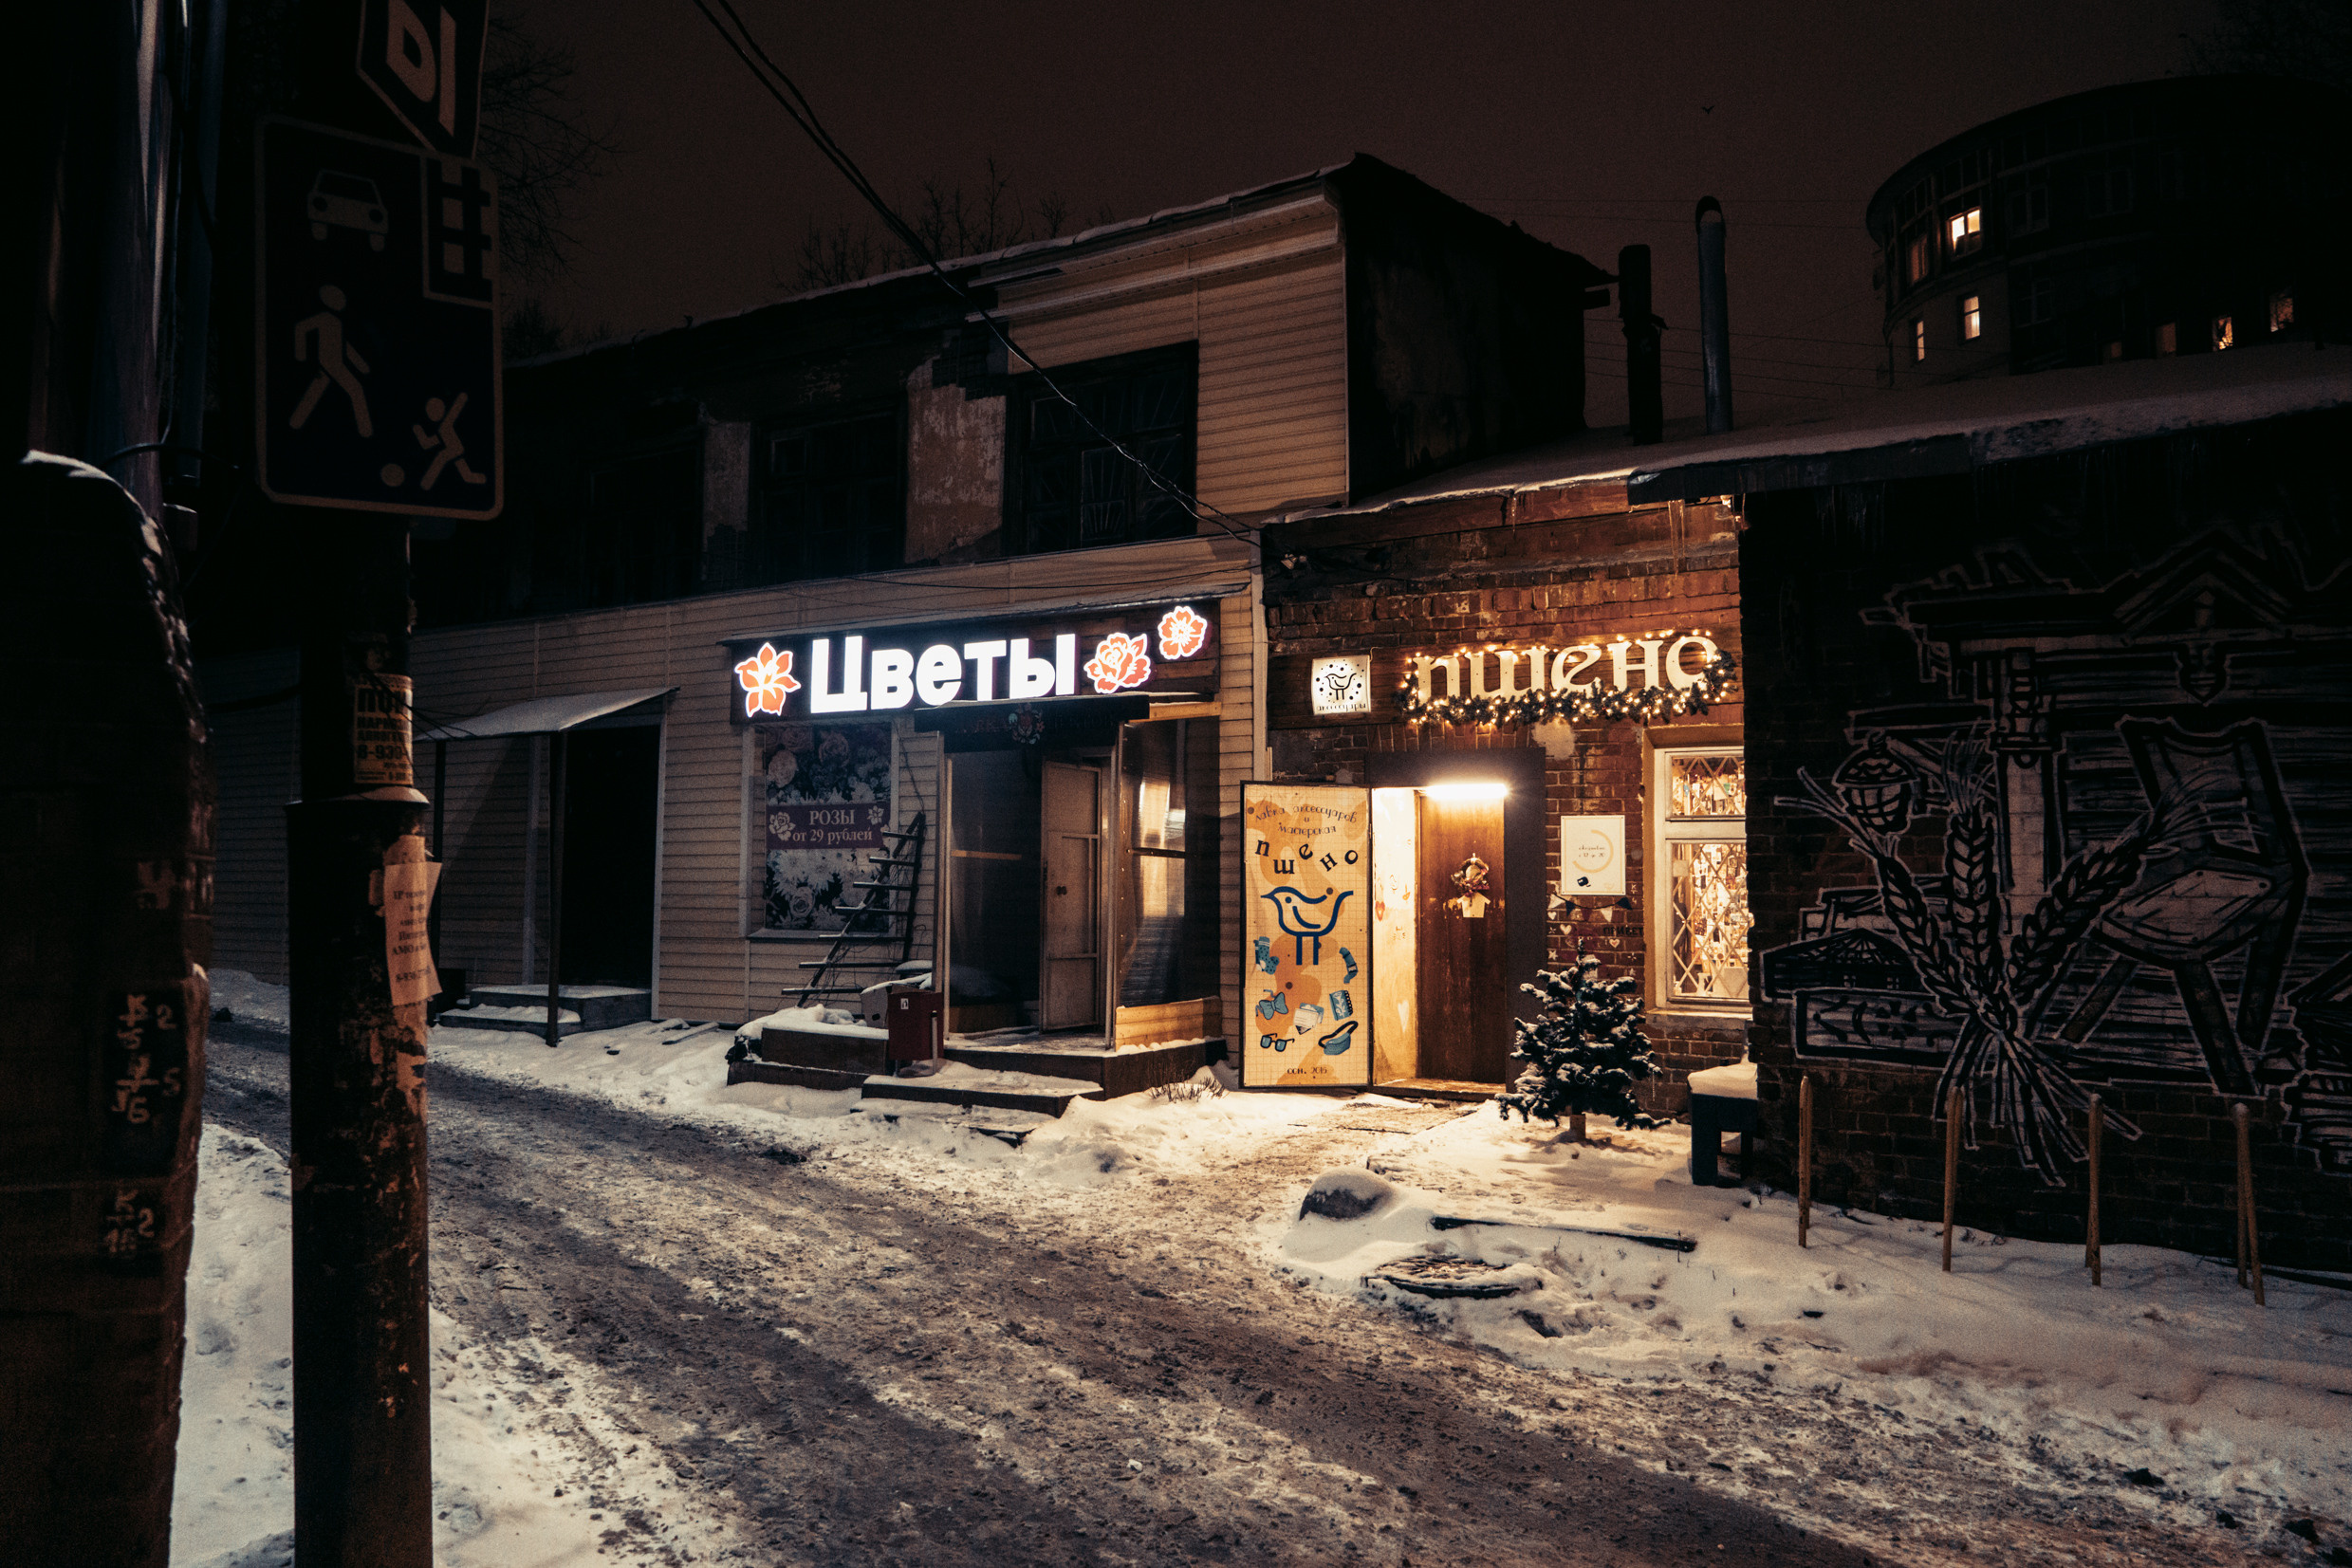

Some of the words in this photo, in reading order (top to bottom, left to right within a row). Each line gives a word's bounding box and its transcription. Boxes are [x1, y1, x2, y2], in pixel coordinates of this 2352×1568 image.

[810, 633, 1076, 713] Цветы
[1412, 635, 1718, 706] пшено
[809, 809, 855, 825] РОЗЫ
[1255, 805, 1286, 822] лавка
[1293, 805, 1358, 823] аксессуаров
[792, 831, 806, 842] от
[809, 829, 824, 842] 29
[827, 827, 873, 845] рублей
[1278, 824, 1337, 839] мастерская
[1254, 839, 1359, 875] пшено
